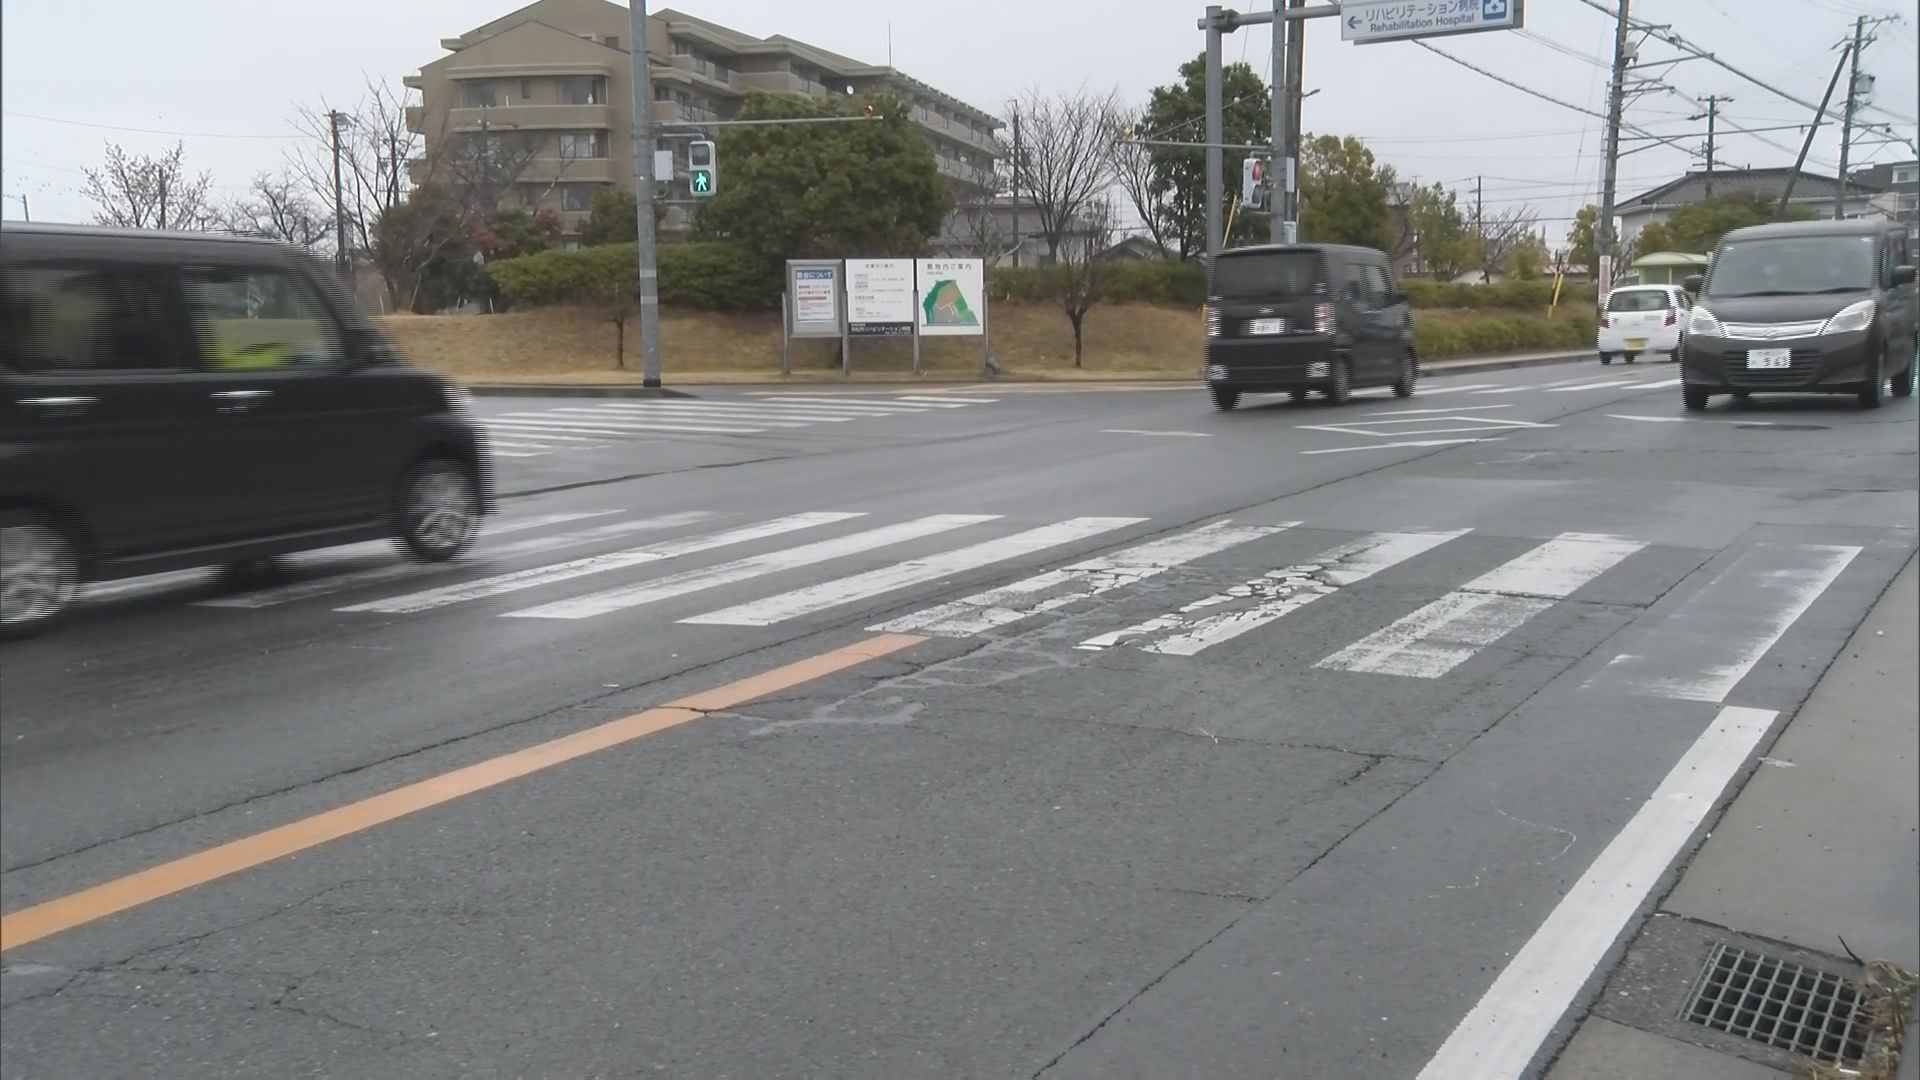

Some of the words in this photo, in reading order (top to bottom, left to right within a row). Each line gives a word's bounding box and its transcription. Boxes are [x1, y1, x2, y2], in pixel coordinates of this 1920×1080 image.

[1365, 0, 1480, 22] リハビリテーション病院
[1370, 19, 1433, 33] Rehabilitation
[1436, 13, 1475, 26] Hospital
